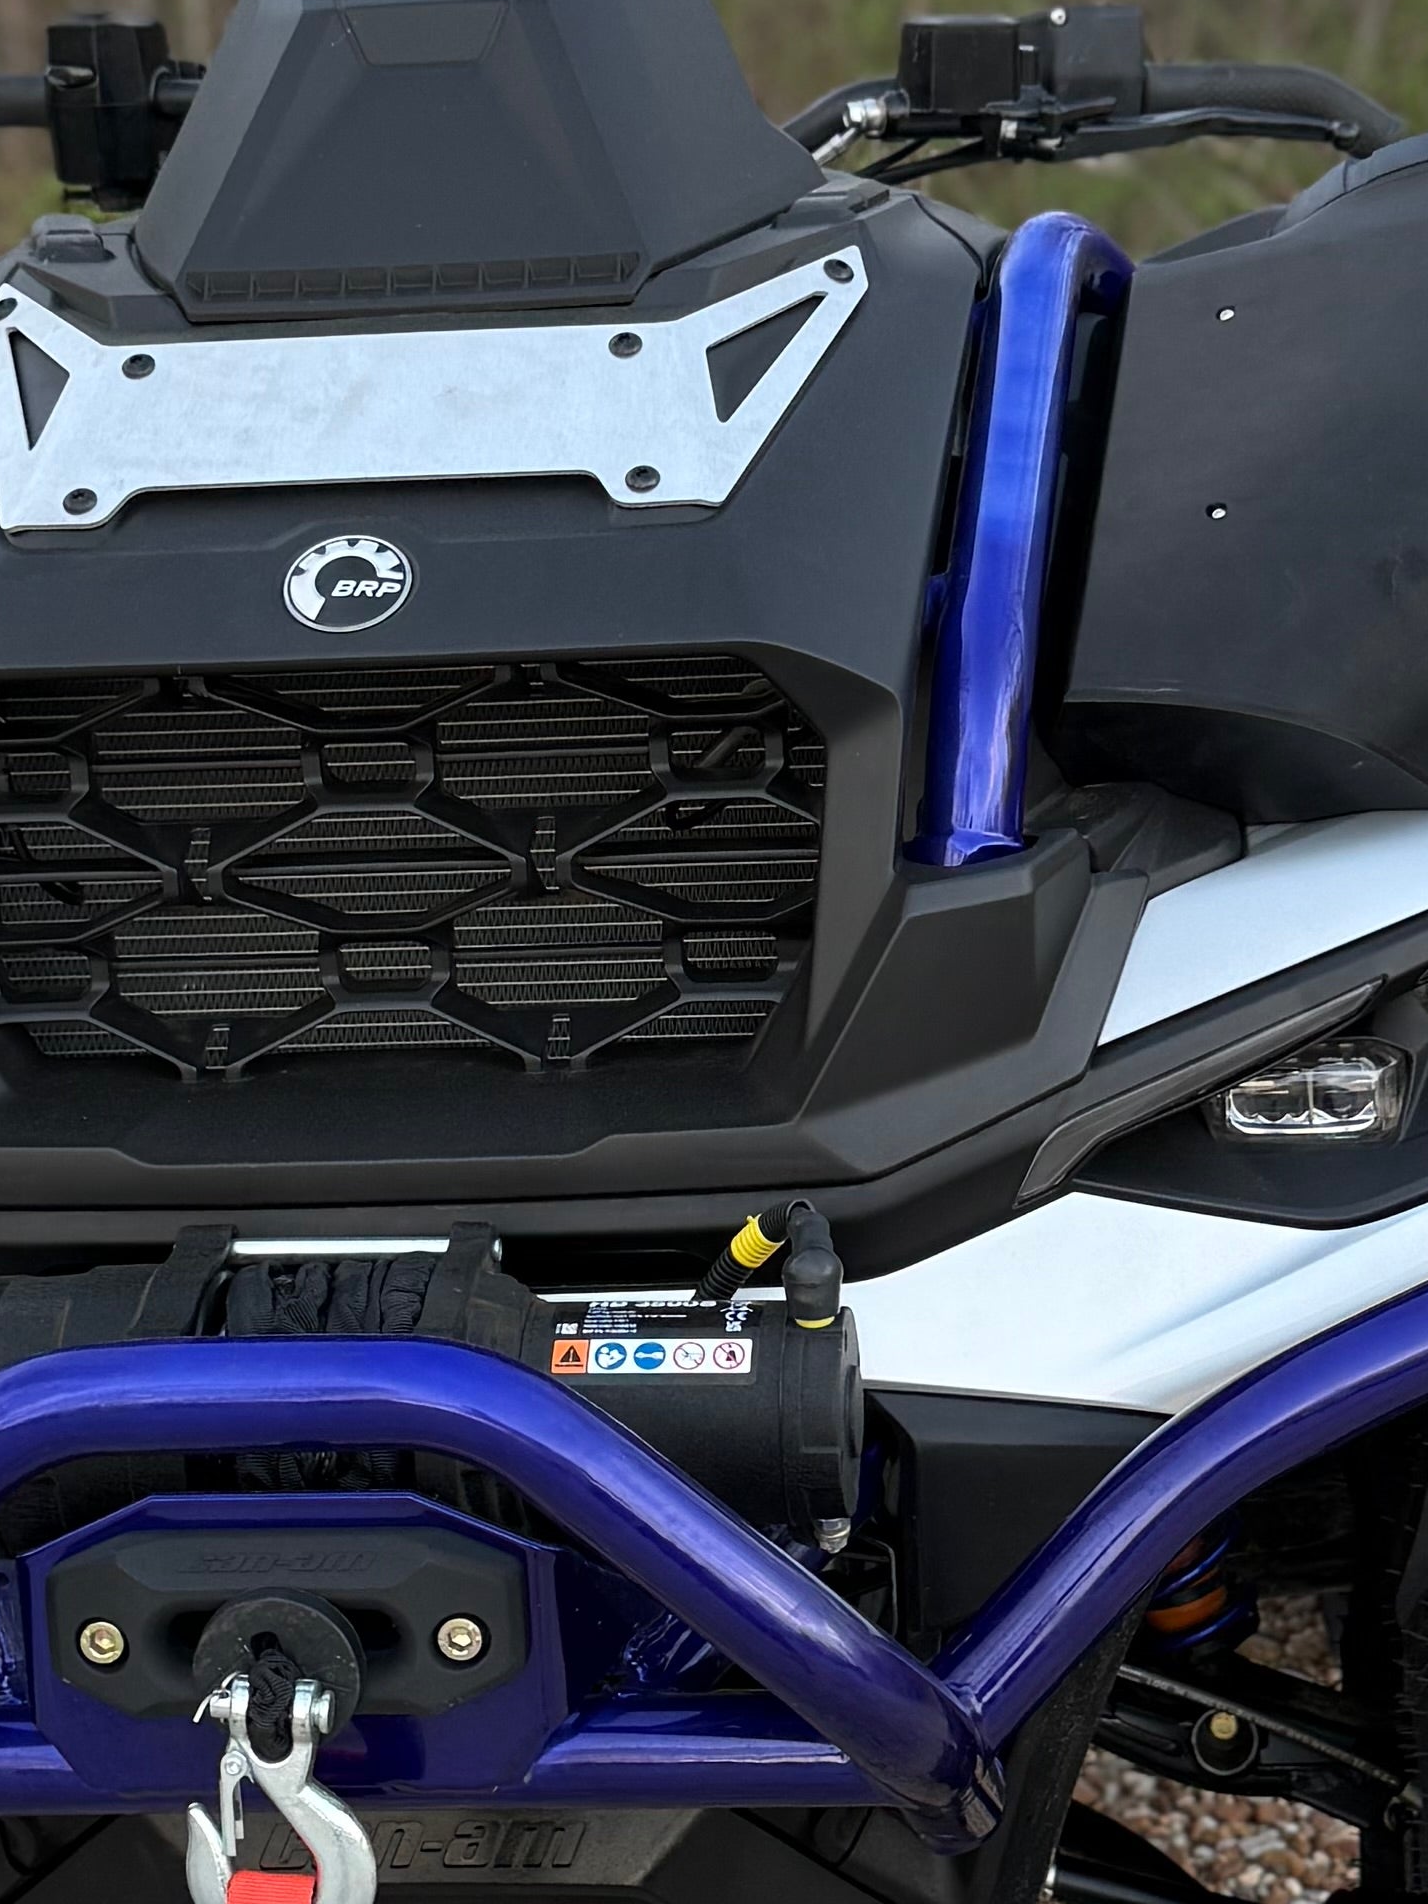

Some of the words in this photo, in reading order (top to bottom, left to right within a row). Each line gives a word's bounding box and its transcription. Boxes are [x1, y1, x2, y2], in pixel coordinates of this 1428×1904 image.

[330, 579, 402, 598] BRP
[176, 1551, 376, 1574] can-am
[259, 1820, 587, 1870] cn-am
